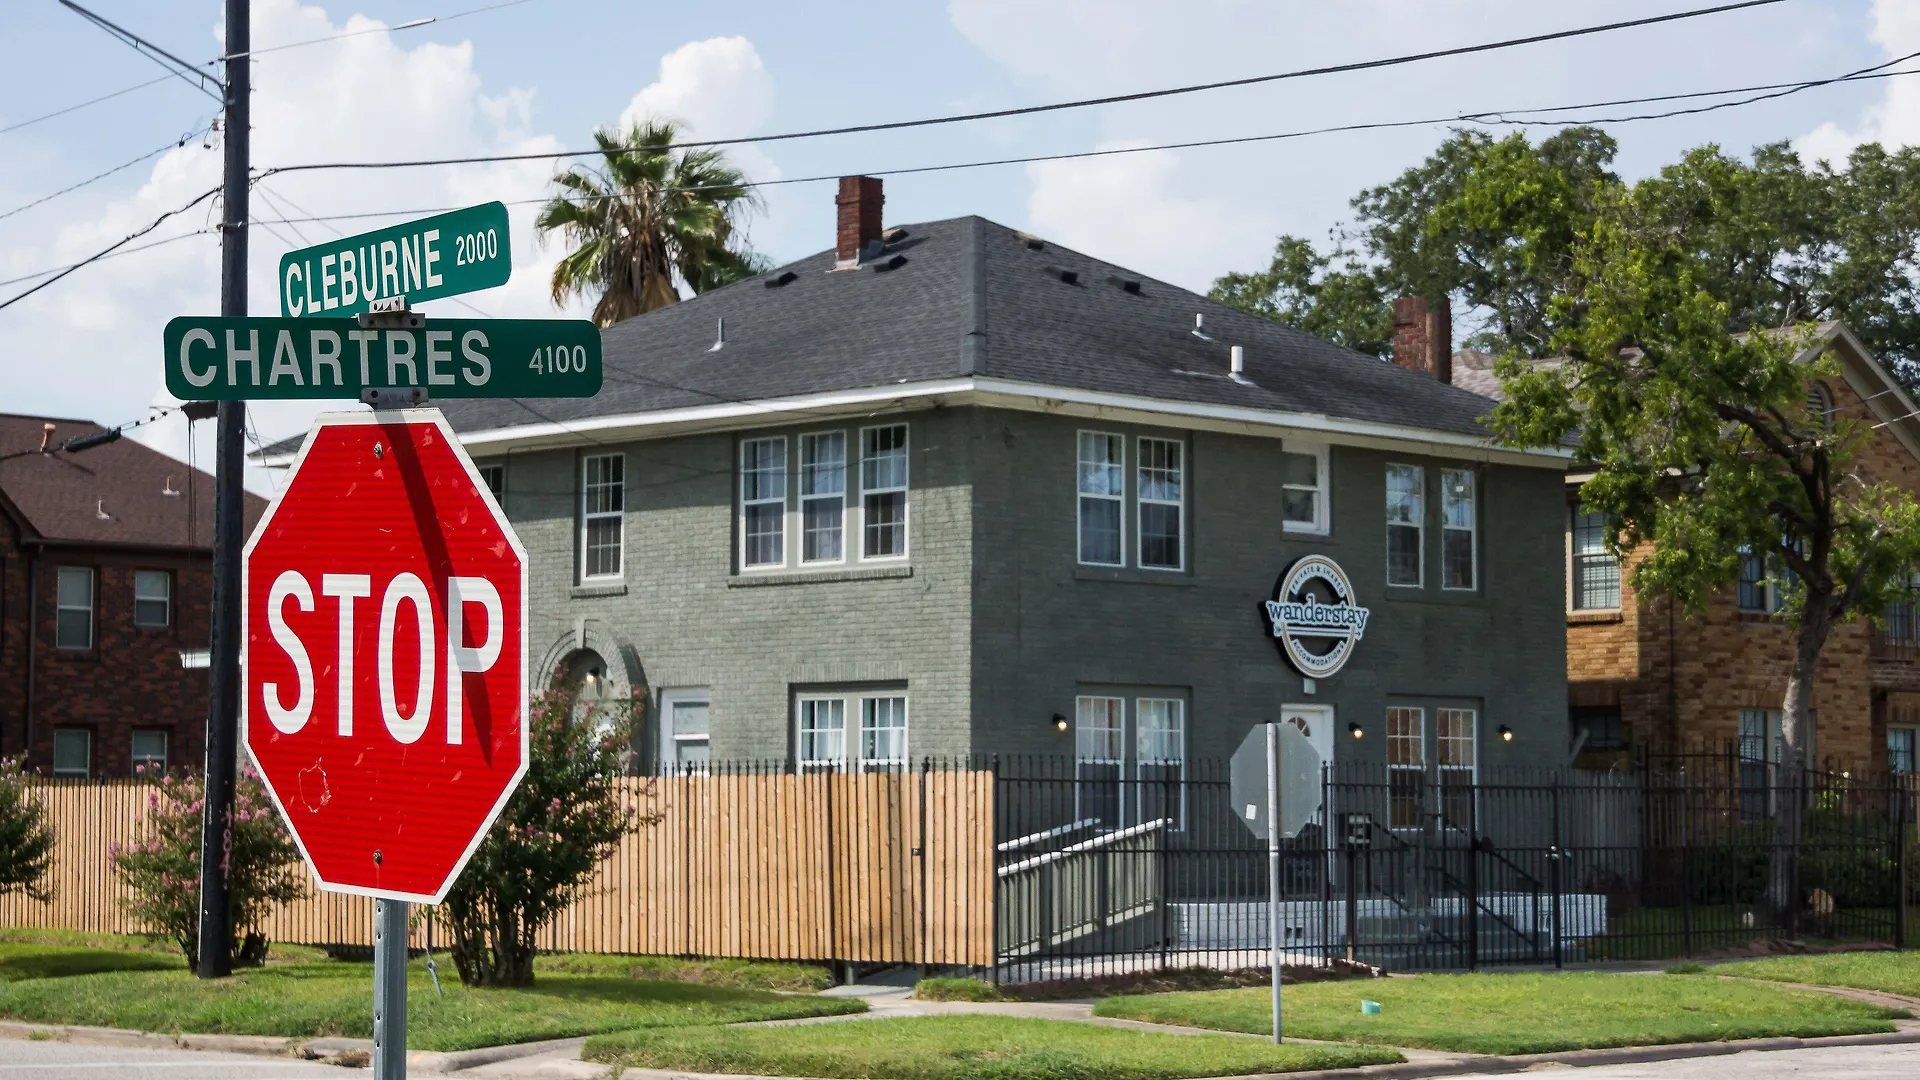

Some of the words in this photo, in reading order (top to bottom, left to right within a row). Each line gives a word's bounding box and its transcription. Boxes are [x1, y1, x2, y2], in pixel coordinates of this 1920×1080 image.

[285, 229, 443, 318] CLEBURNE
[455, 228, 498, 266] 2000
[179, 328, 492, 387] CHARTRES
[529, 344, 588, 375] 4100
[1291, 565, 1314, 590] PRIVATE
[1323, 566, 1344, 593] SHARED
[1267, 595, 1368, 629] wanderstay
[262, 570, 504, 745] STOP
[1293, 641, 1345, 667] ACCOMMODATIONS
